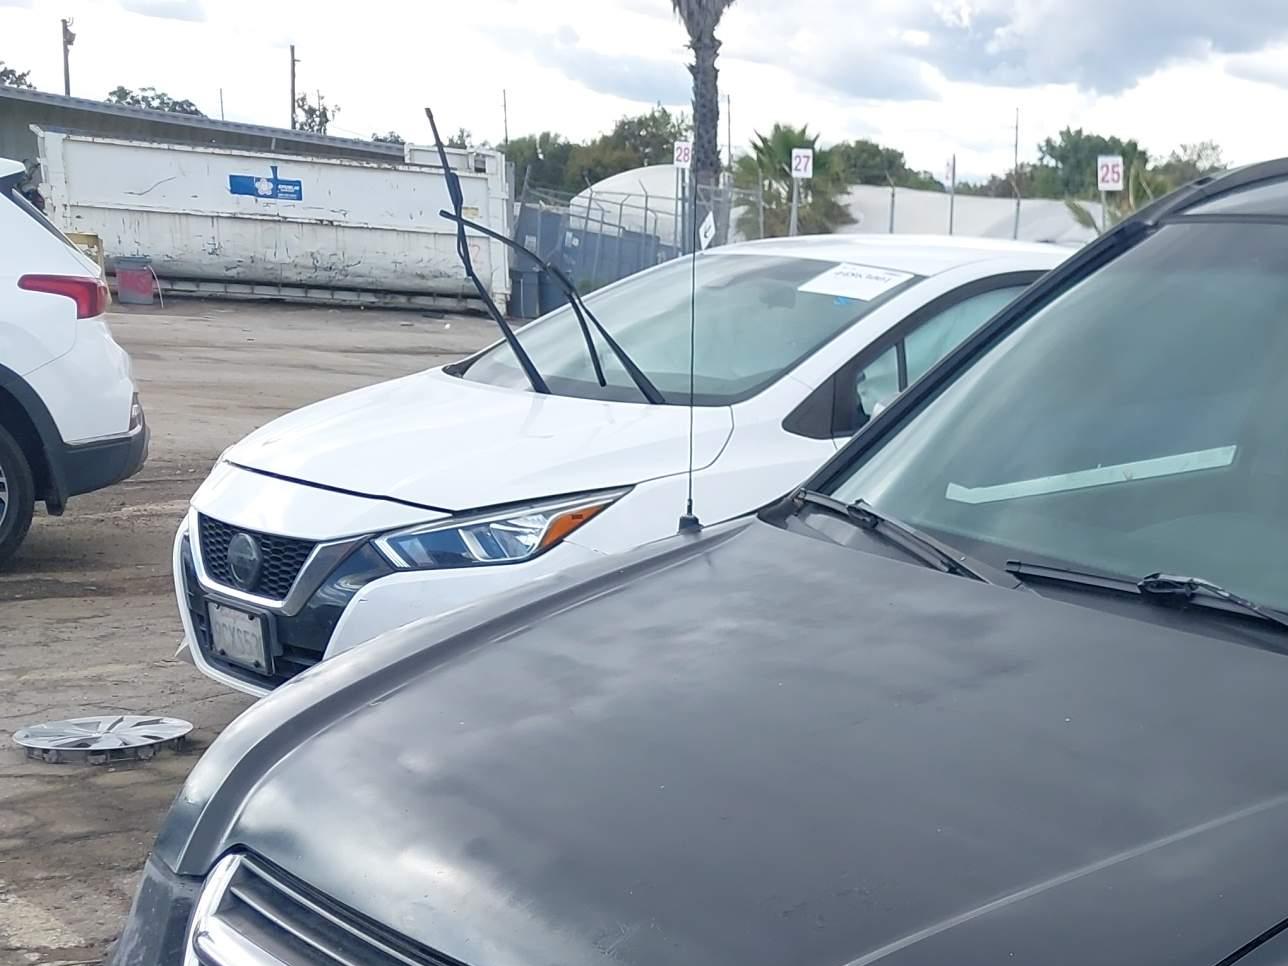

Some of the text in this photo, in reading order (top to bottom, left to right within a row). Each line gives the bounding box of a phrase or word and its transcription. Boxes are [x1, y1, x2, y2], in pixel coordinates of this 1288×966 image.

[676, 147, 690, 162] 28
[794, 155, 811, 173] 27
[1101, 163, 1121, 183] 25
